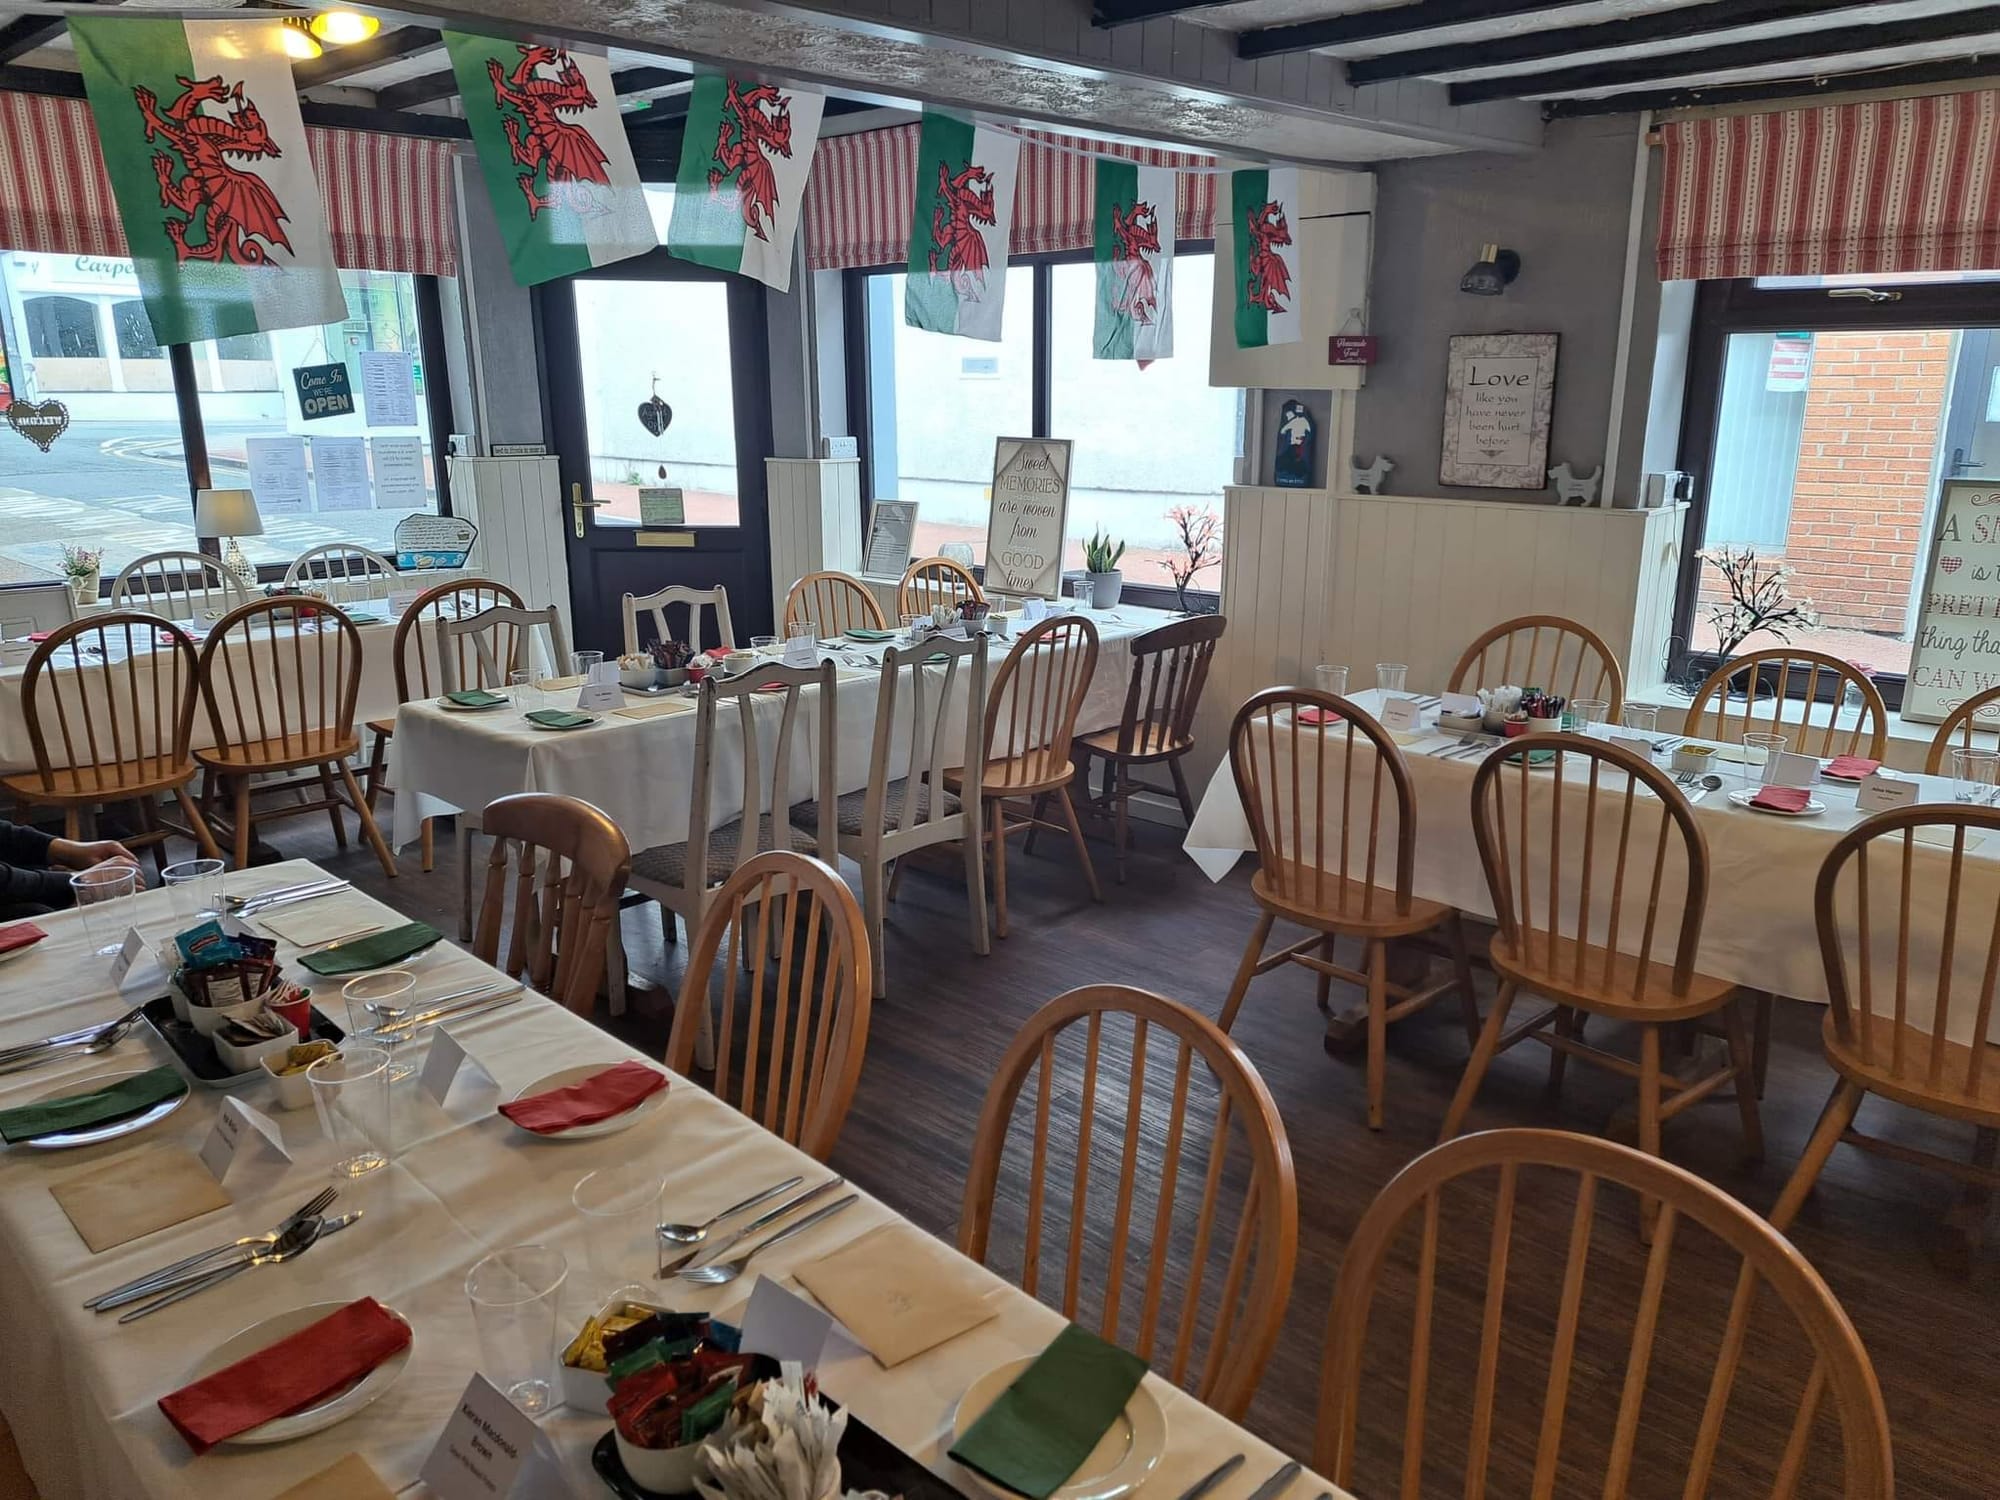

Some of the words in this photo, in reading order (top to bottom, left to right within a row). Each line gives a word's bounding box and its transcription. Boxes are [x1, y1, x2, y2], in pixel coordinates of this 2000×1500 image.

[75, 256, 138, 279] Carpe
[301, 372, 326, 390] Come
[330, 369, 342, 384] In
[1468, 366, 1530, 386] Love
[312, 386, 335, 397] WE'RE
[1475, 392, 1495, 403] like
[1498, 395, 1518, 405] you
[304, 394, 350, 415] OPEN
[1466, 405, 1492, 417] have
[1495, 409, 1526, 417] never
[1469, 420, 1495, 431] been
[1498, 421, 1520, 431] hurt
[1475, 435, 1510, 447] before
[1015, 452, 1050, 472] Sweet
[1000, 475, 1061, 494] MEMORIES
[999, 500, 1018, 514] are
[1022, 503, 1056, 518] woven
[1008, 517, 1039, 545] from
[1937, 513, 1962, 542] A
[1001, 551, 1044, 570] GOOD
[1006, 570, 1034, 590] times
[1970, 564, 1992, 581] is
[1920, 625, 1968, 660] thing
[1913, 666, 1967, 690] CAN
